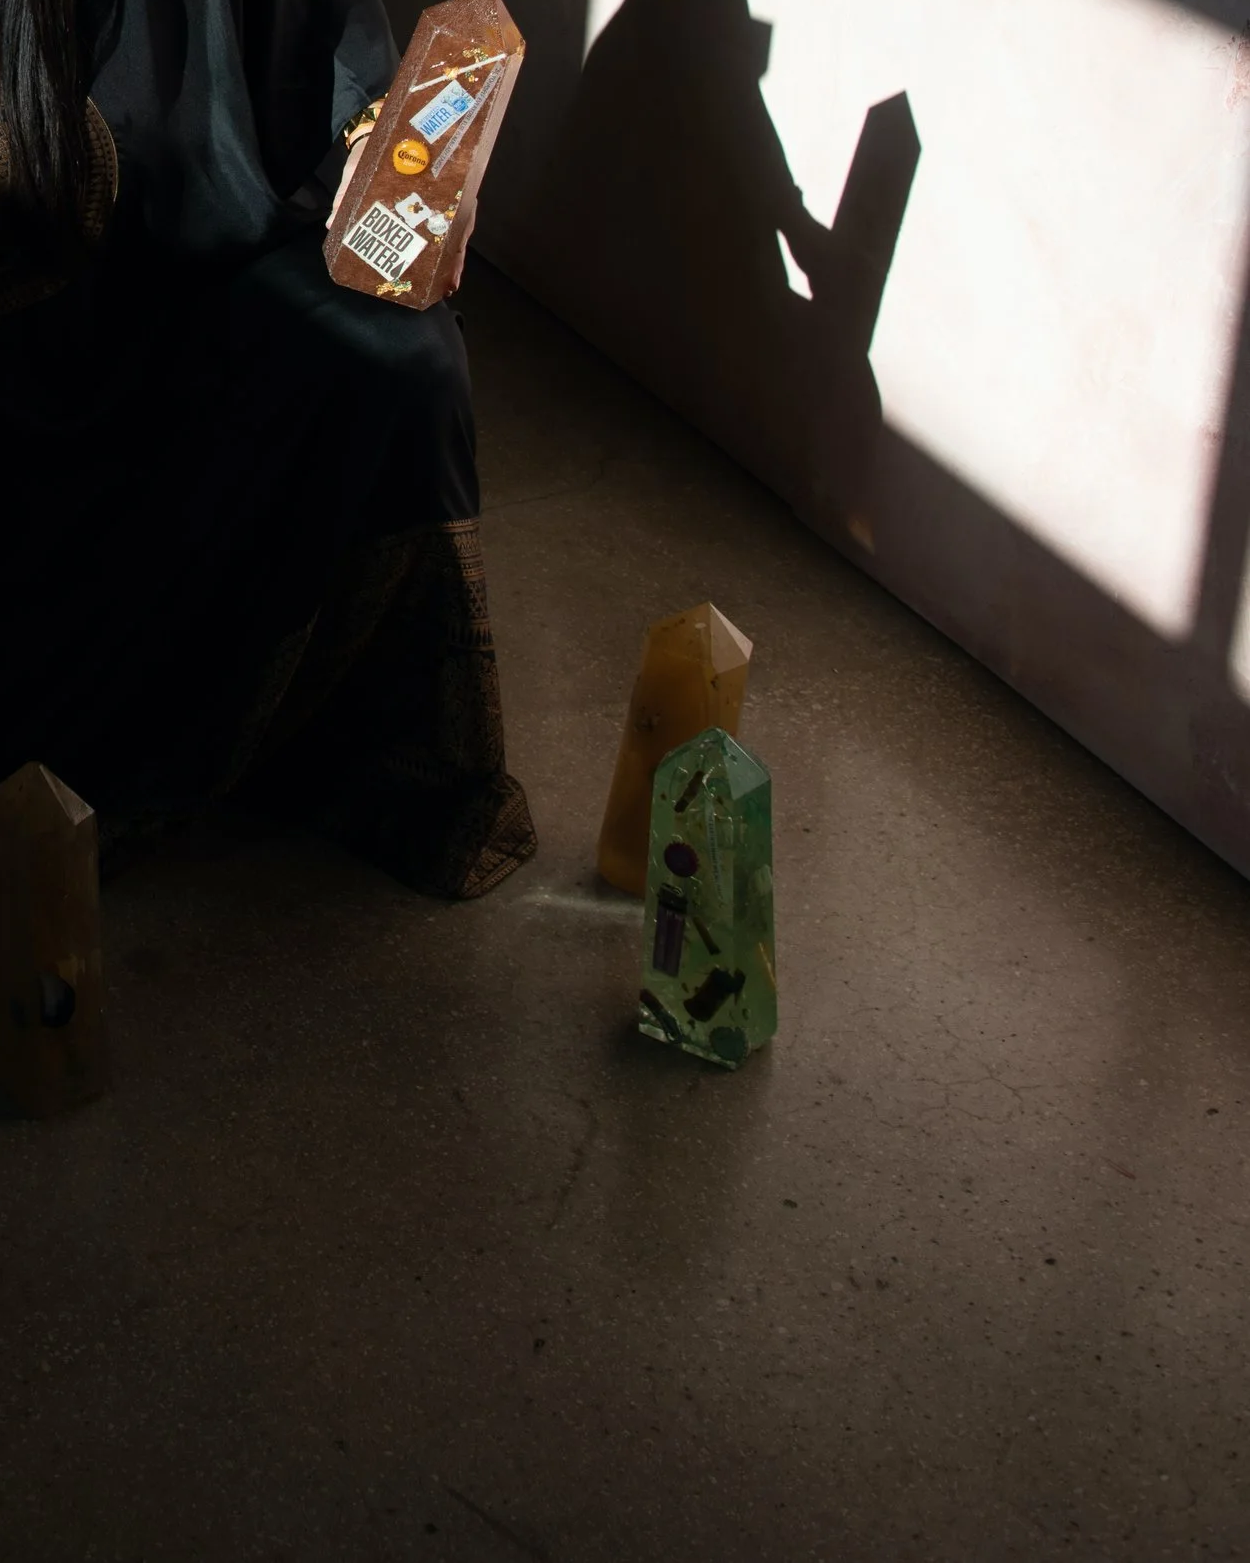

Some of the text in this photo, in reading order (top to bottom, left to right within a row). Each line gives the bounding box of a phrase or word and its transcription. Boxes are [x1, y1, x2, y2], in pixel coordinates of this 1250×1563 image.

[420, 107, 452, 135] WATER
[398, 150, 426, 166] Corona
[362, 207, 414, 252] BOXED
[347, 226, 399, 273] WATER
